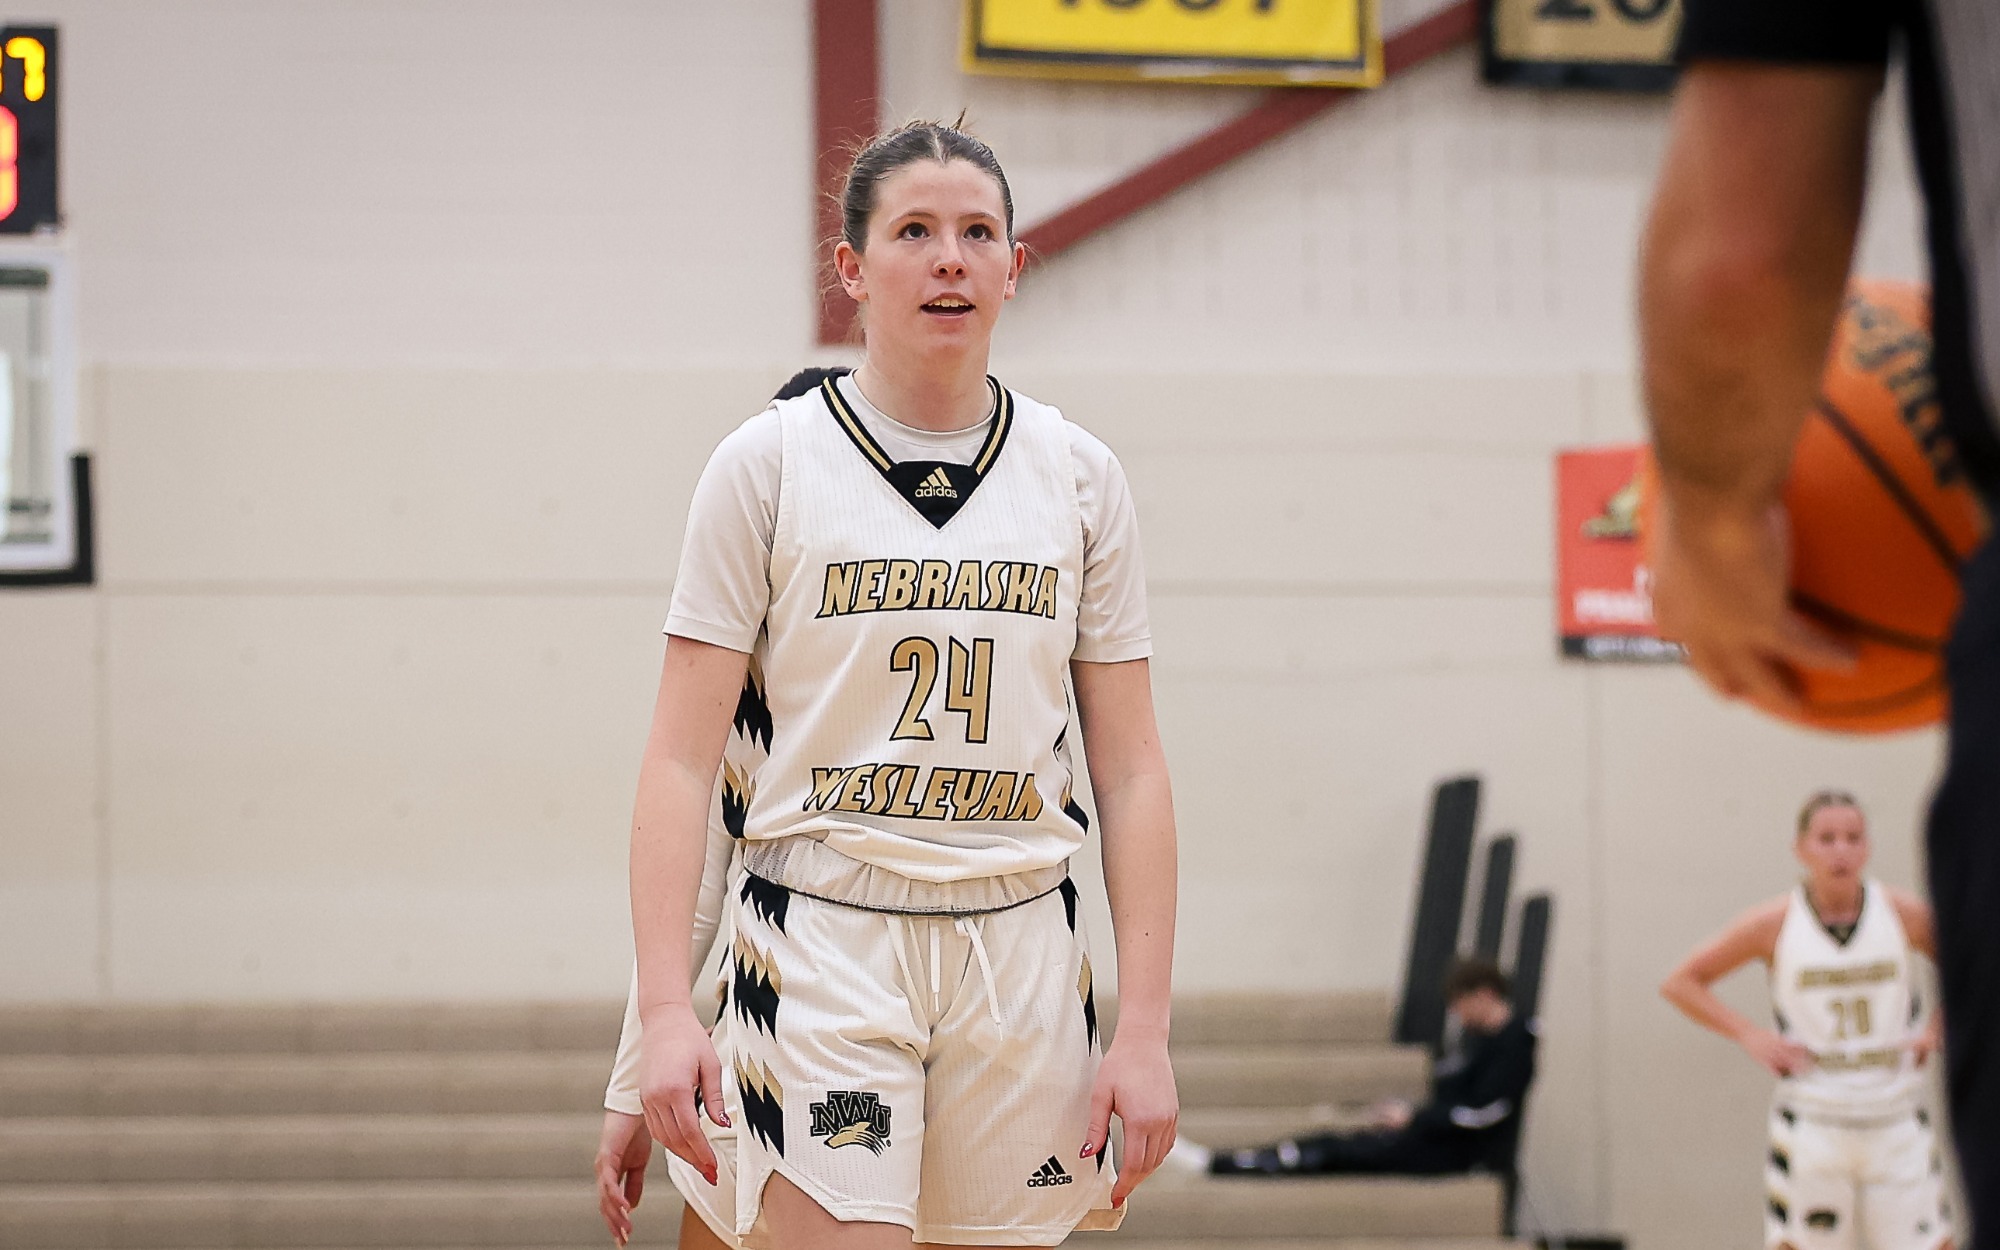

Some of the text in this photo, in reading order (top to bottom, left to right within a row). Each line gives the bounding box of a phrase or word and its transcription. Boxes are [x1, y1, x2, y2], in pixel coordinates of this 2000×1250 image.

[915, 485, 958, 499] adidas
[814, 559, 1059, 620] NEBRASKA
[889, 635, 994, 744] 24
[803, 764, 1044, 822] WESLEYAN
[810, 1091, 891, 1137] NWU
[1027, 1173, 1073, 1187] adidas
